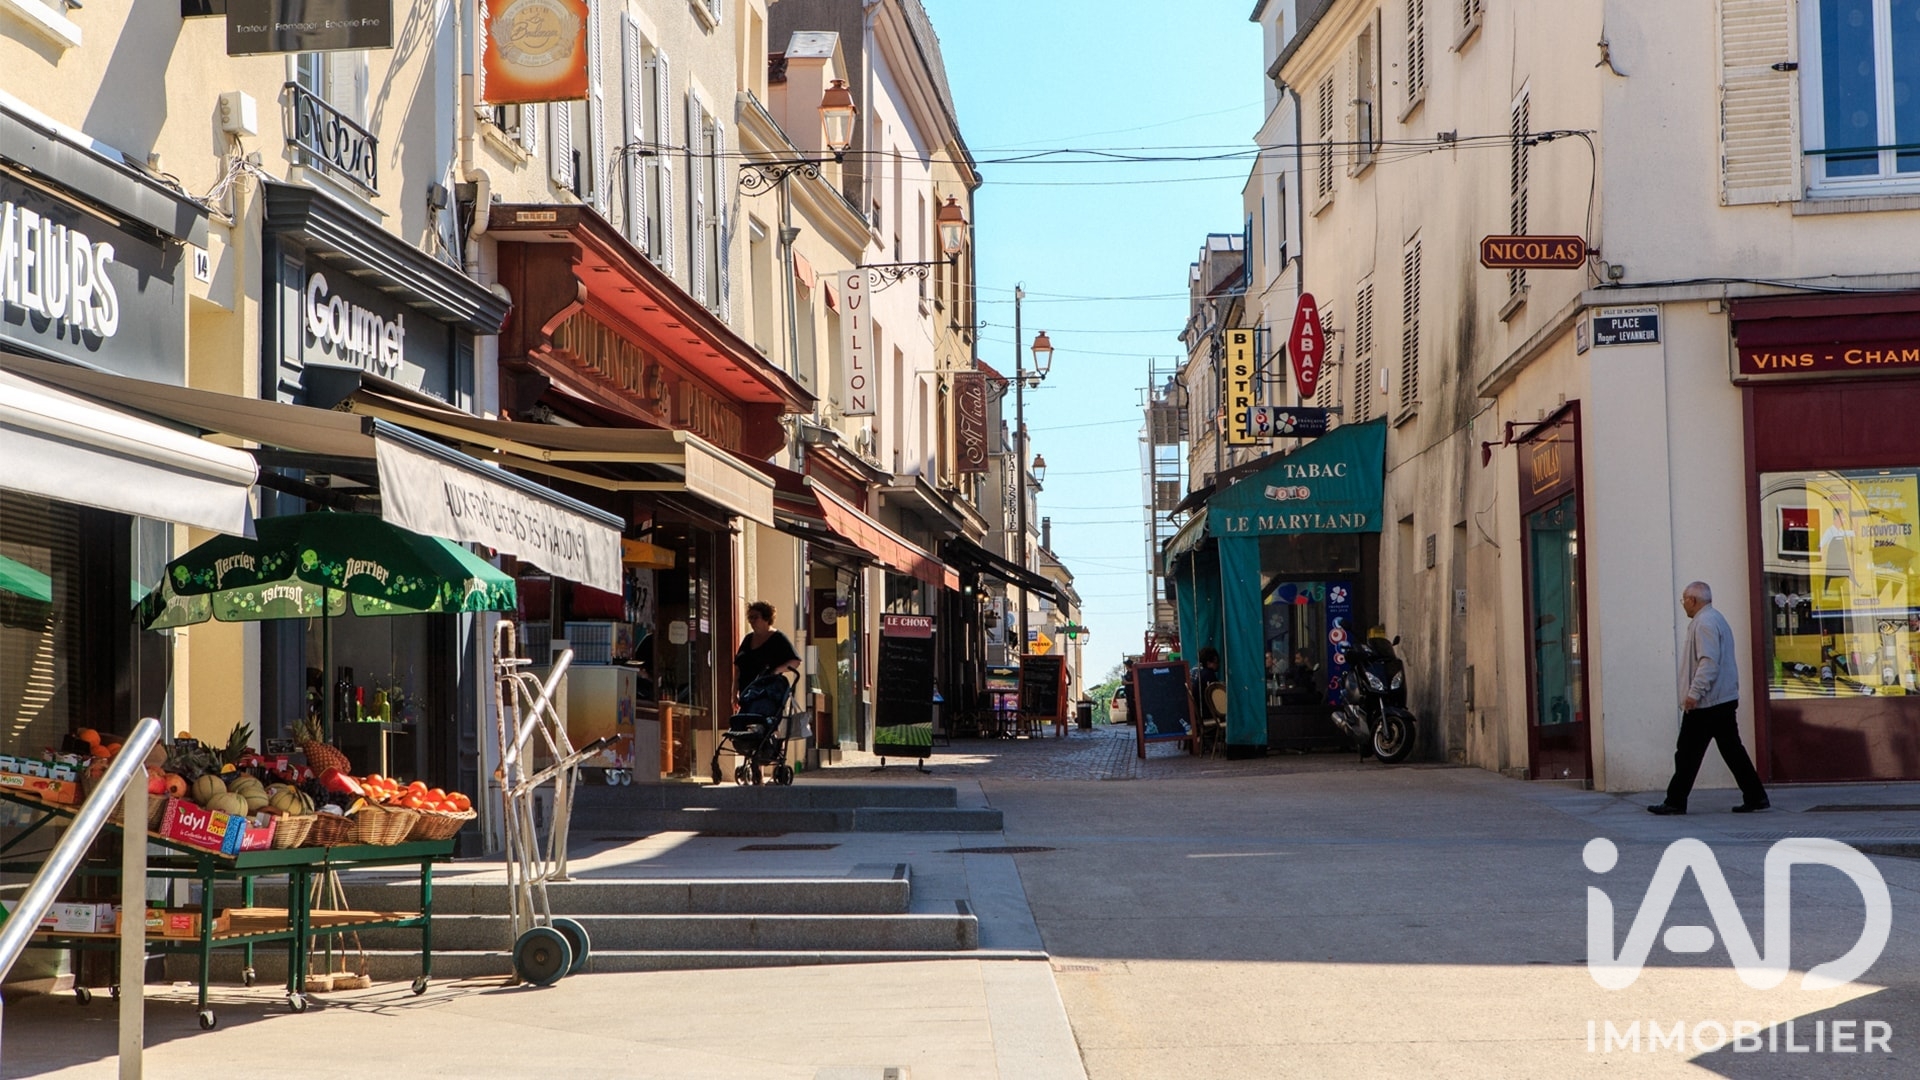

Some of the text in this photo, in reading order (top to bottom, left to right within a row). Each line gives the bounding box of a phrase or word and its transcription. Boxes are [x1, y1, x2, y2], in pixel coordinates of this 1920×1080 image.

[236, 24, 268, 33] Traiteur
[275, 22, 318, 32] Fromager
[361, 18, 380, 27] Fine
[1488, 243, 1578, 261] NICOLAS
[307, 272, 406, 371] Gourmet
[1611, 317, 1640, 329] PLACE
[846, 274, 867, 410] GUILLON
[1301, 307, 1314, 383] TABAC
[1597, 330, 1656, 344] Roger LEVANNEUR
[1233, 333, 1249, 440] BISTROT
[1284, 463, 1347, 479] TABAC
[444, 481, 474, 520] AUX
[1225, 512, 1367, 532] LE MARYLAND
[887, 617, 929, 628] LE CHOIX
[179, 808, 206, 831] idyl
